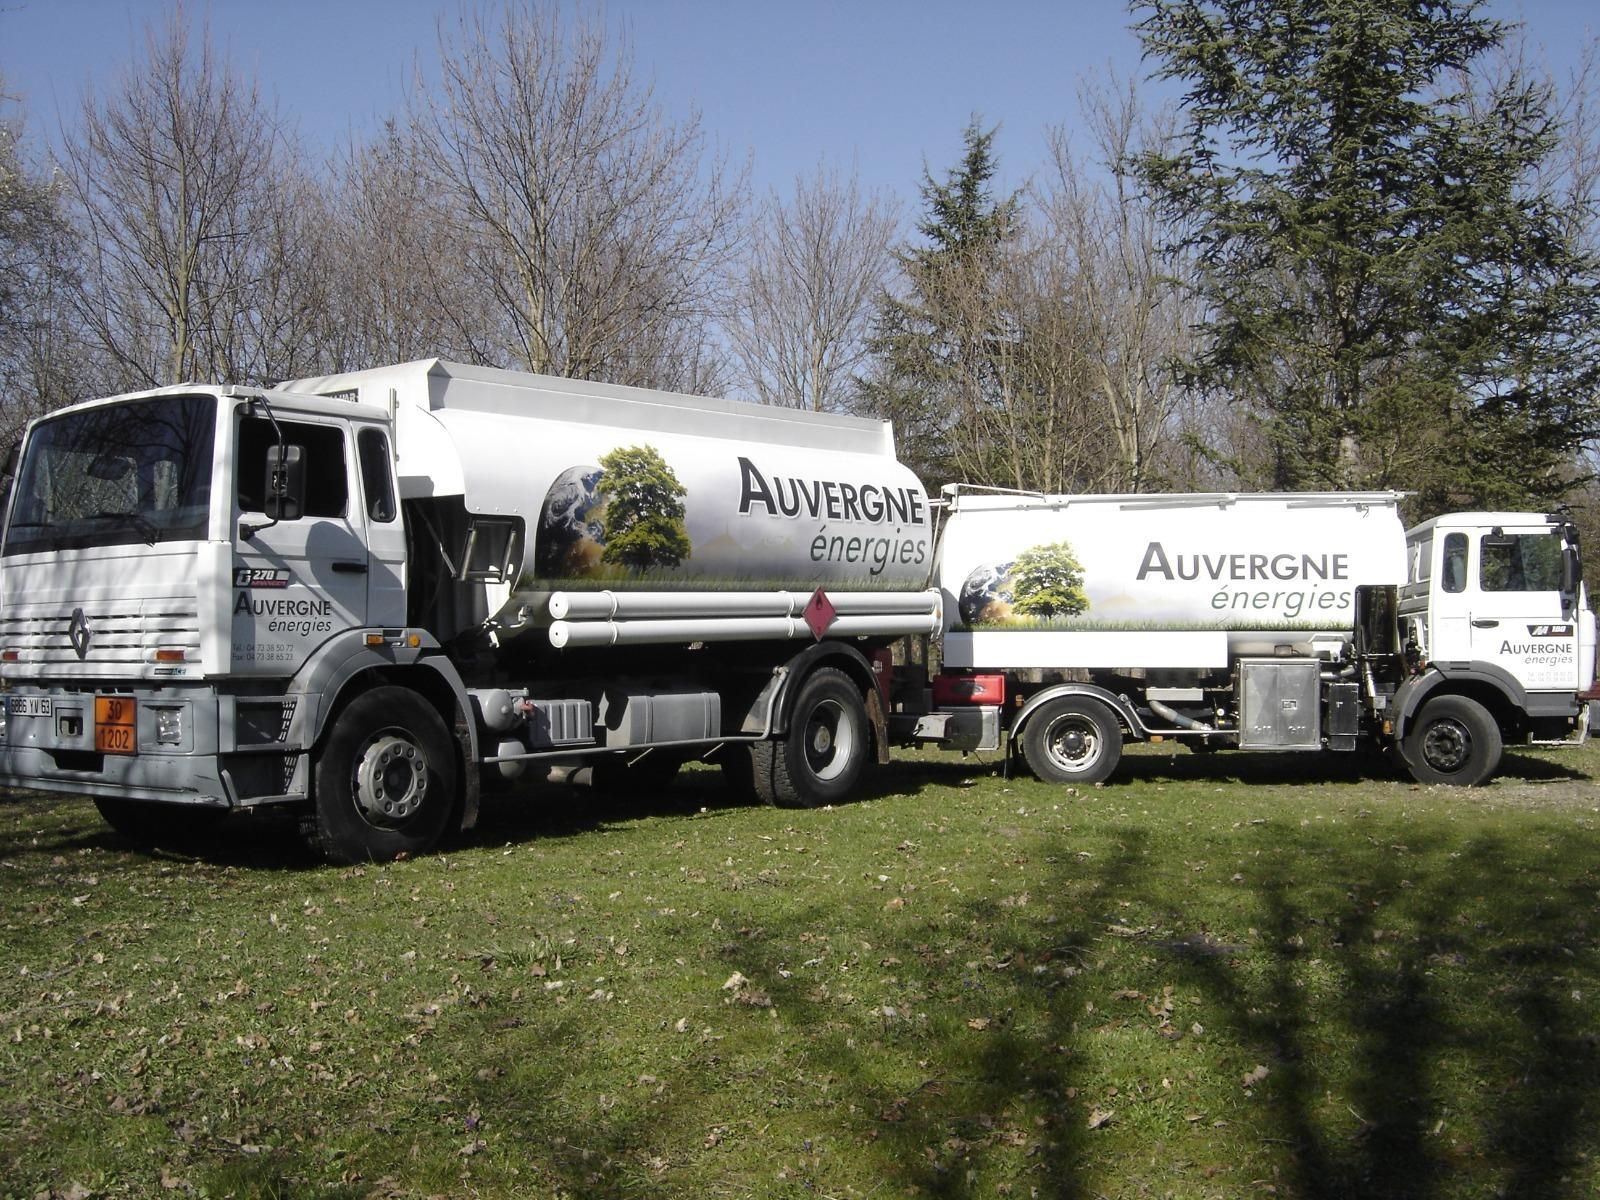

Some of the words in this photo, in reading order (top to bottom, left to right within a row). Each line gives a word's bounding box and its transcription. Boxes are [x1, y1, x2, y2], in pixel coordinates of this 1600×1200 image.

[738, 456, 924, 525] AUVERGNE
[810, 525, 926, 576] énergies
[1136, 541, 1349, 581] AUVERGNE
[252, 570, 275, 580] 270
[234, 591, 332, 616] AUVERGNE
[1211, 584, 1351, 618] énergies
[268, 616, 332, 637] énergies
[1499, 640, 1573, 655] AUVERGNE
[41, 700, 50, 714] 63
[107, 701, 122, 720] 30
[101, 728, 129, 749] 1202
